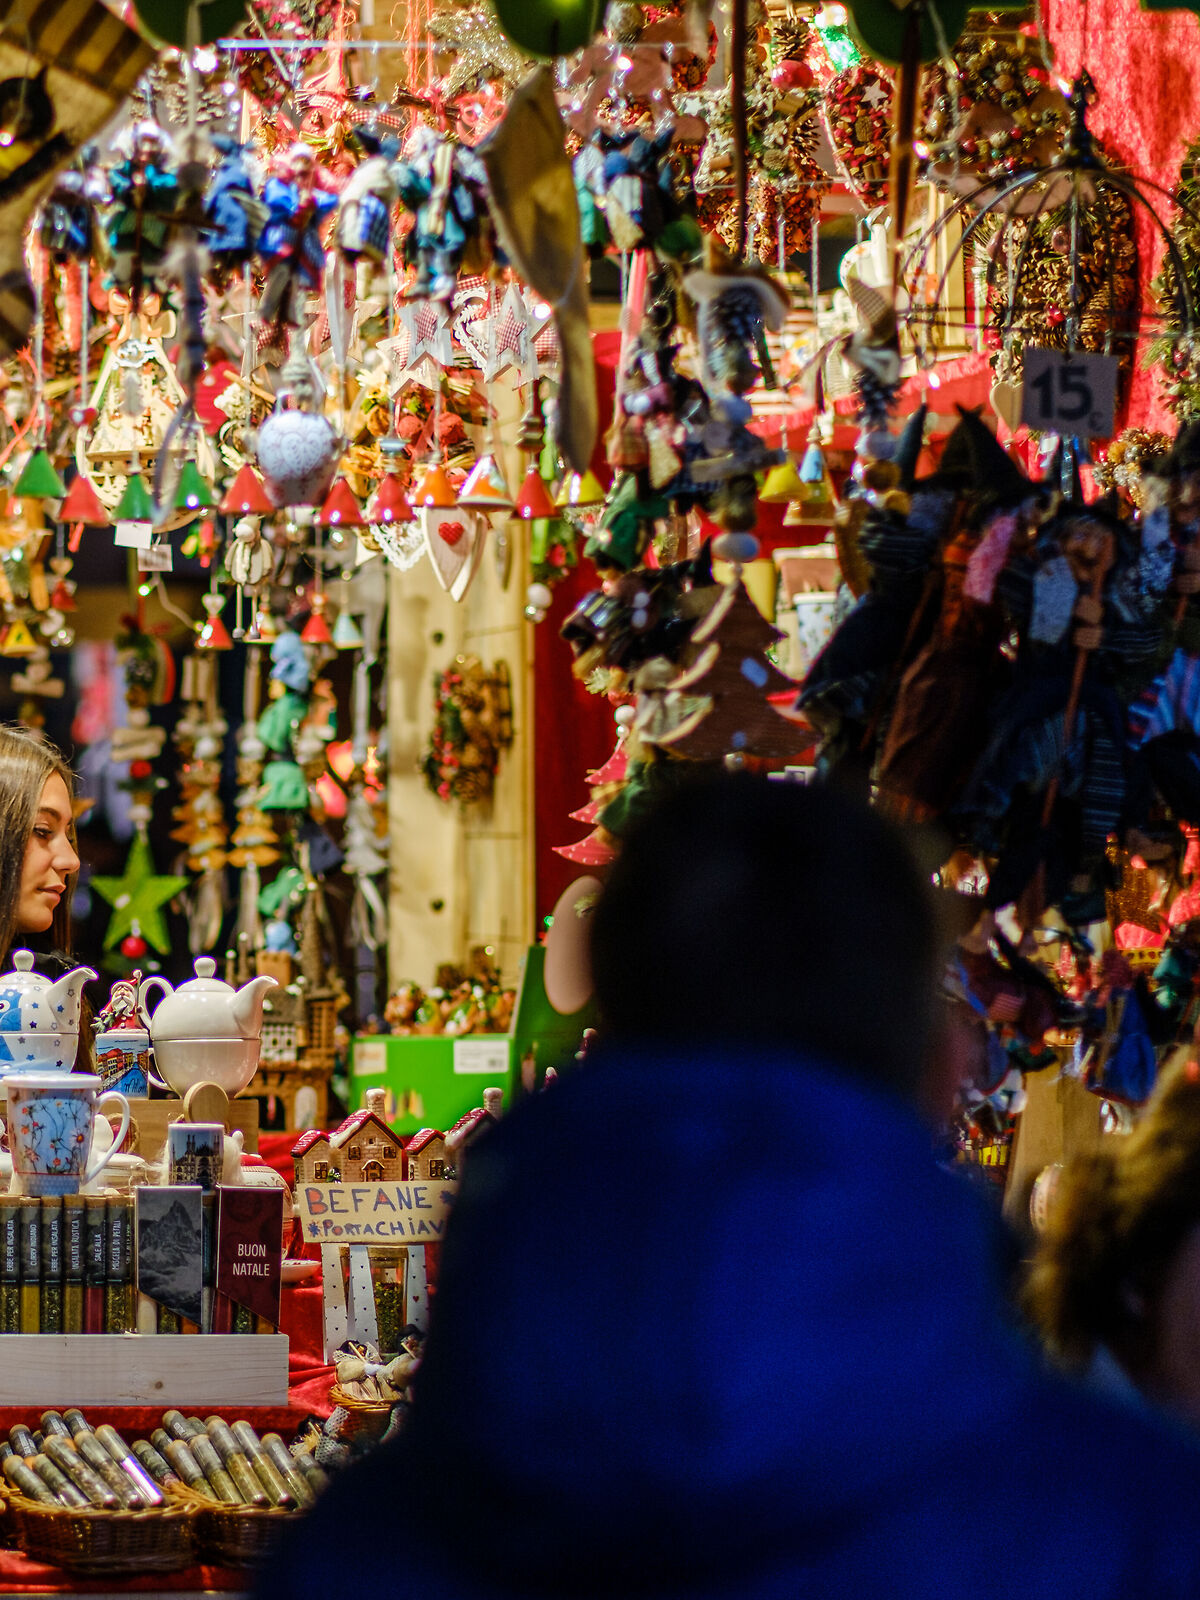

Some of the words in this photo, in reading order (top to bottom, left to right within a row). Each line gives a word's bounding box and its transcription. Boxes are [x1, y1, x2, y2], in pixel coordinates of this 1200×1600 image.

[1030, 365, 1093, 421] 15
[304, 1186, 433, 1216] BEFANE
[6, 1219, 14, 1245] INSALATA
[112, 1220, 120, 1237] PETALI
[322, 1217, 444, 1238] PORTACHIAV
[94, 1234, 102, 1247] ALLA
[6, 1246, 14, 1257] PER
[94, 1249, 102, 1262] SALE
[112, 1247, 120, 1270] MISCELA
[238, 1243, 266, 1258] BUON
[6, 1258, 14, 1272] ERBE
[232, 1262, 270, 1277] NATALE
